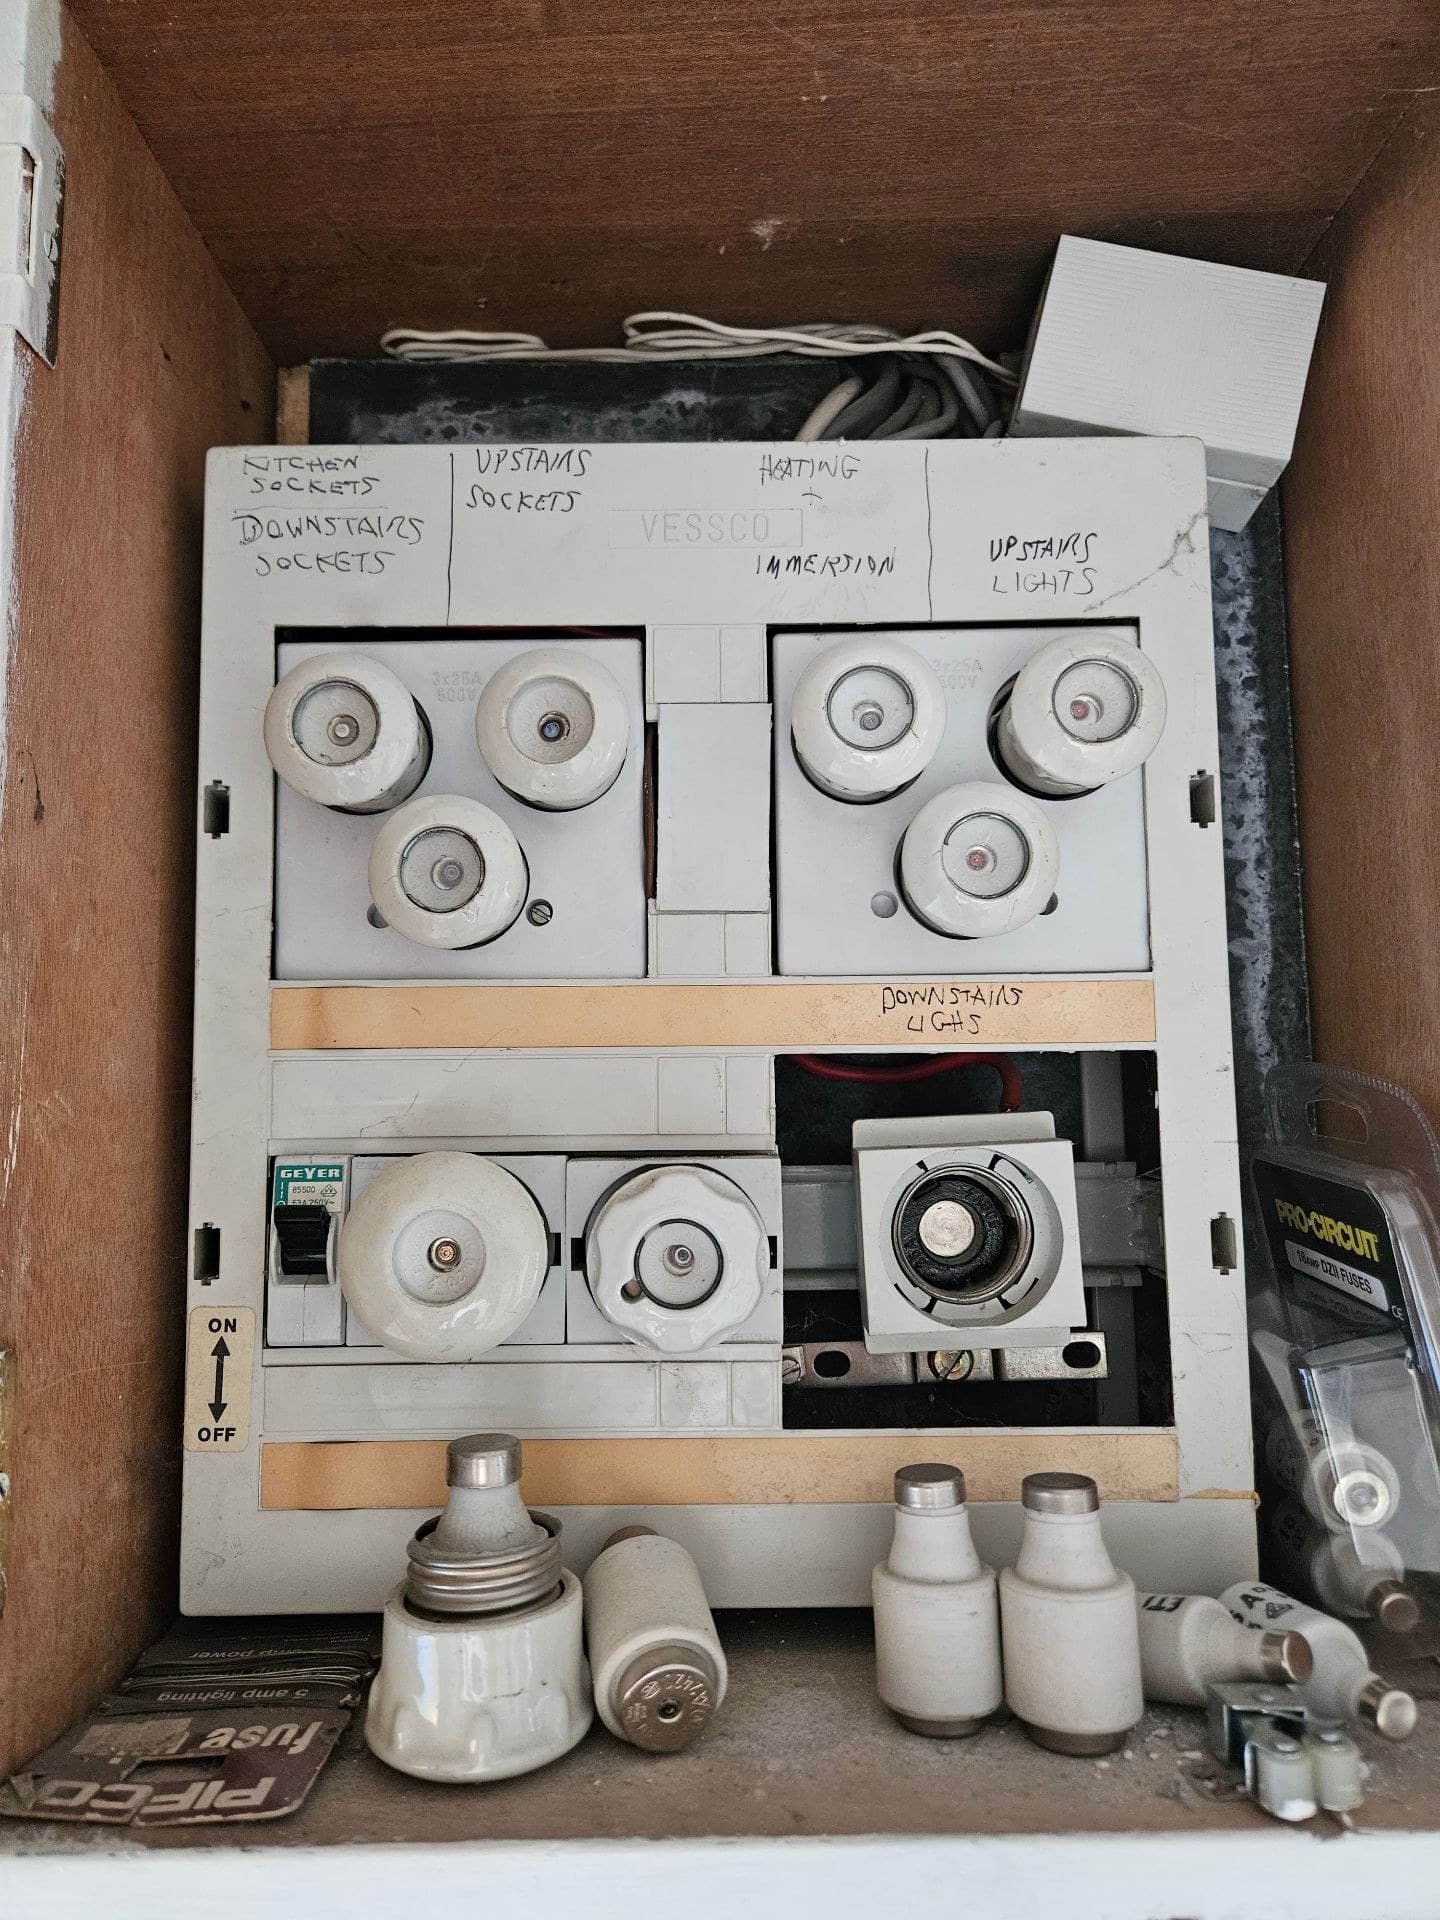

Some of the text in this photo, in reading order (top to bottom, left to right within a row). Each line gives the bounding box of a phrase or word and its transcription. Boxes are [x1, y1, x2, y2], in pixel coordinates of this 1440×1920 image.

[243, 454, 359, 475] KITCHEN
[759, 454, 861, 487] HEATING
[250, 476, 381, 496] SOCKETS
[466, 484, 582, 513] SOCKETS
[231, 513, 425, 546] DOWNSTAIRS
[641, 512, 769, 543] VESSCO
[989, 532, 1098, 564] UPSTAIRS
[255, 550, 397, 577] SOCKETS
[992, 567, 1098, 596] LIGHTS
[882, 985, 1024, 1014] DOWNSTAIRS
[280, 1167, 341, 1180] GEYER
[1340, 1268, 1373, 1294] FUSES
[208, 1318, 237, 1333] ON
[197, 1427, 236, 1442] OFF
[156, 1688, 309, 1702] 5 amp lighting
[199, 1720, 324, 1755] fuse
[41, 1775, 277, 1815] PIFCO
